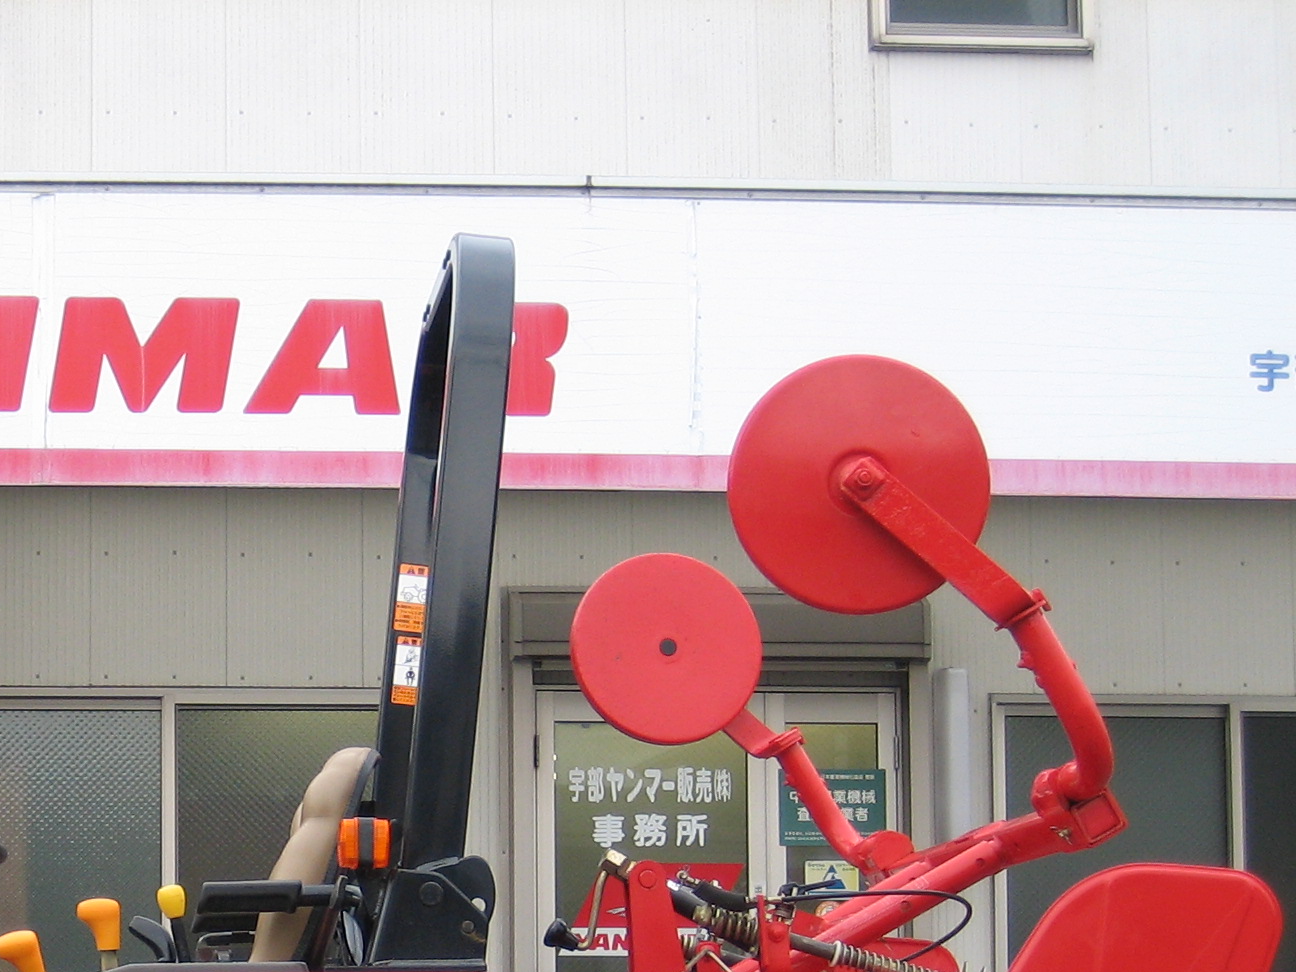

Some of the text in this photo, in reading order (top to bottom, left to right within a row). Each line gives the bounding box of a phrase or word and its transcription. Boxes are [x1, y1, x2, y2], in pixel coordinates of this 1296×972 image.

[1249, 350, 1296, 392] 宇
[592, 814, 709, 847] 事務所
